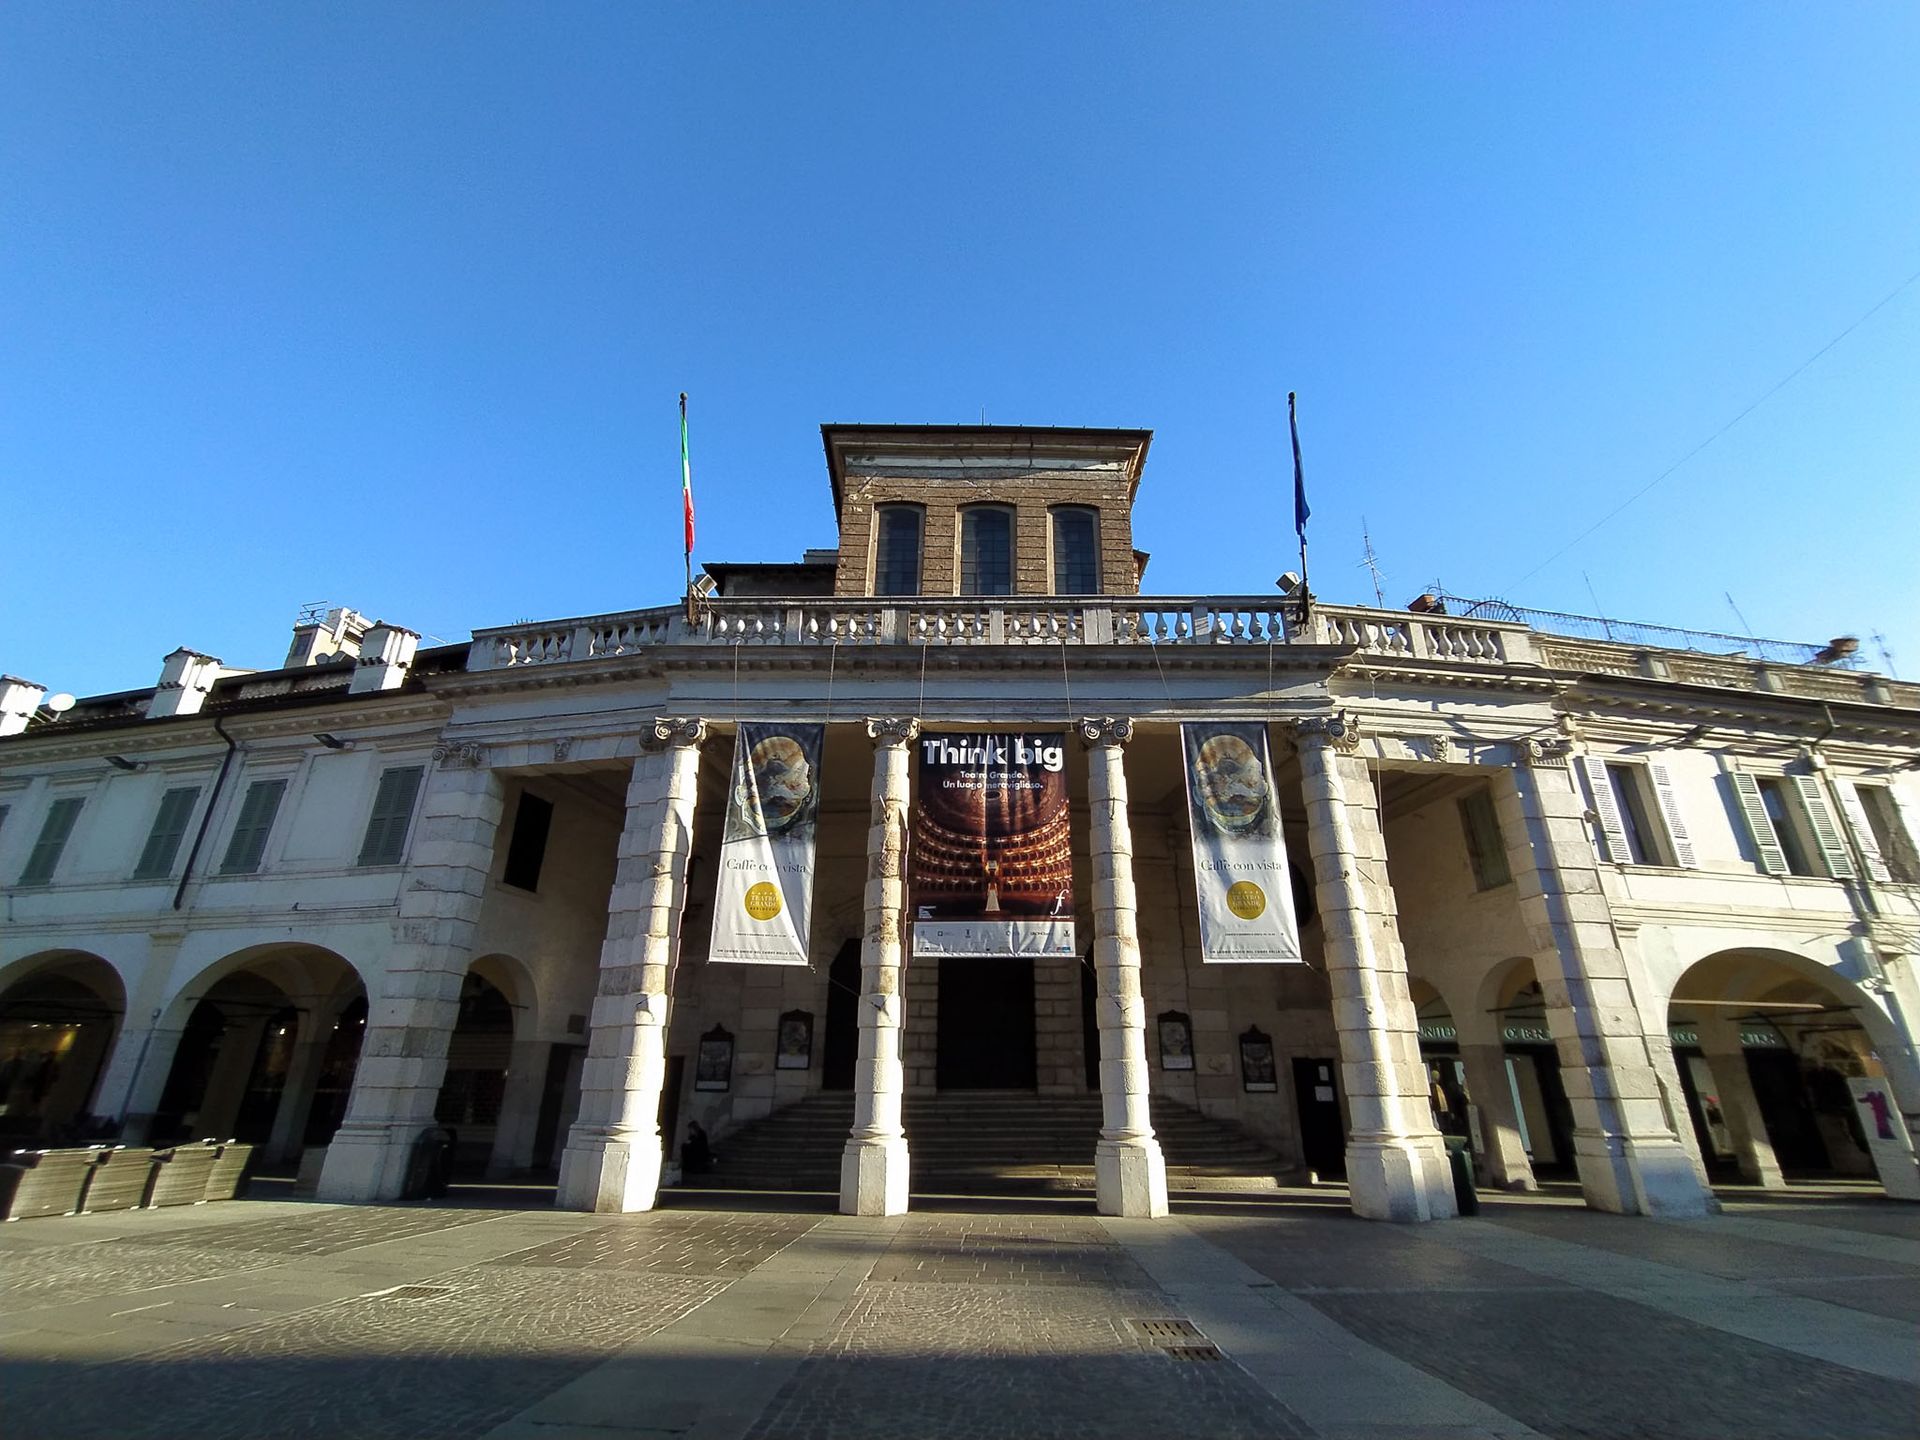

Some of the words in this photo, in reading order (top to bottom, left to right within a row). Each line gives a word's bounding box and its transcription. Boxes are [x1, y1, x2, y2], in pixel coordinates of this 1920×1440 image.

[923, 738, 1007, 765] Think
[1015, 738, 1064, 772] big
[960, 770, 987, 779] Teatro
[943, 781, 956, 789] Un
[957, 781, 983, 790] luogo
[726, 858, 757, 871] Caffè
[782, 861, 806, 873] vista
[1200, 859, 1231, 871] Caffè
[1233, 863, 1255, 871] con
[1256, 859, 1282, 871] vista
